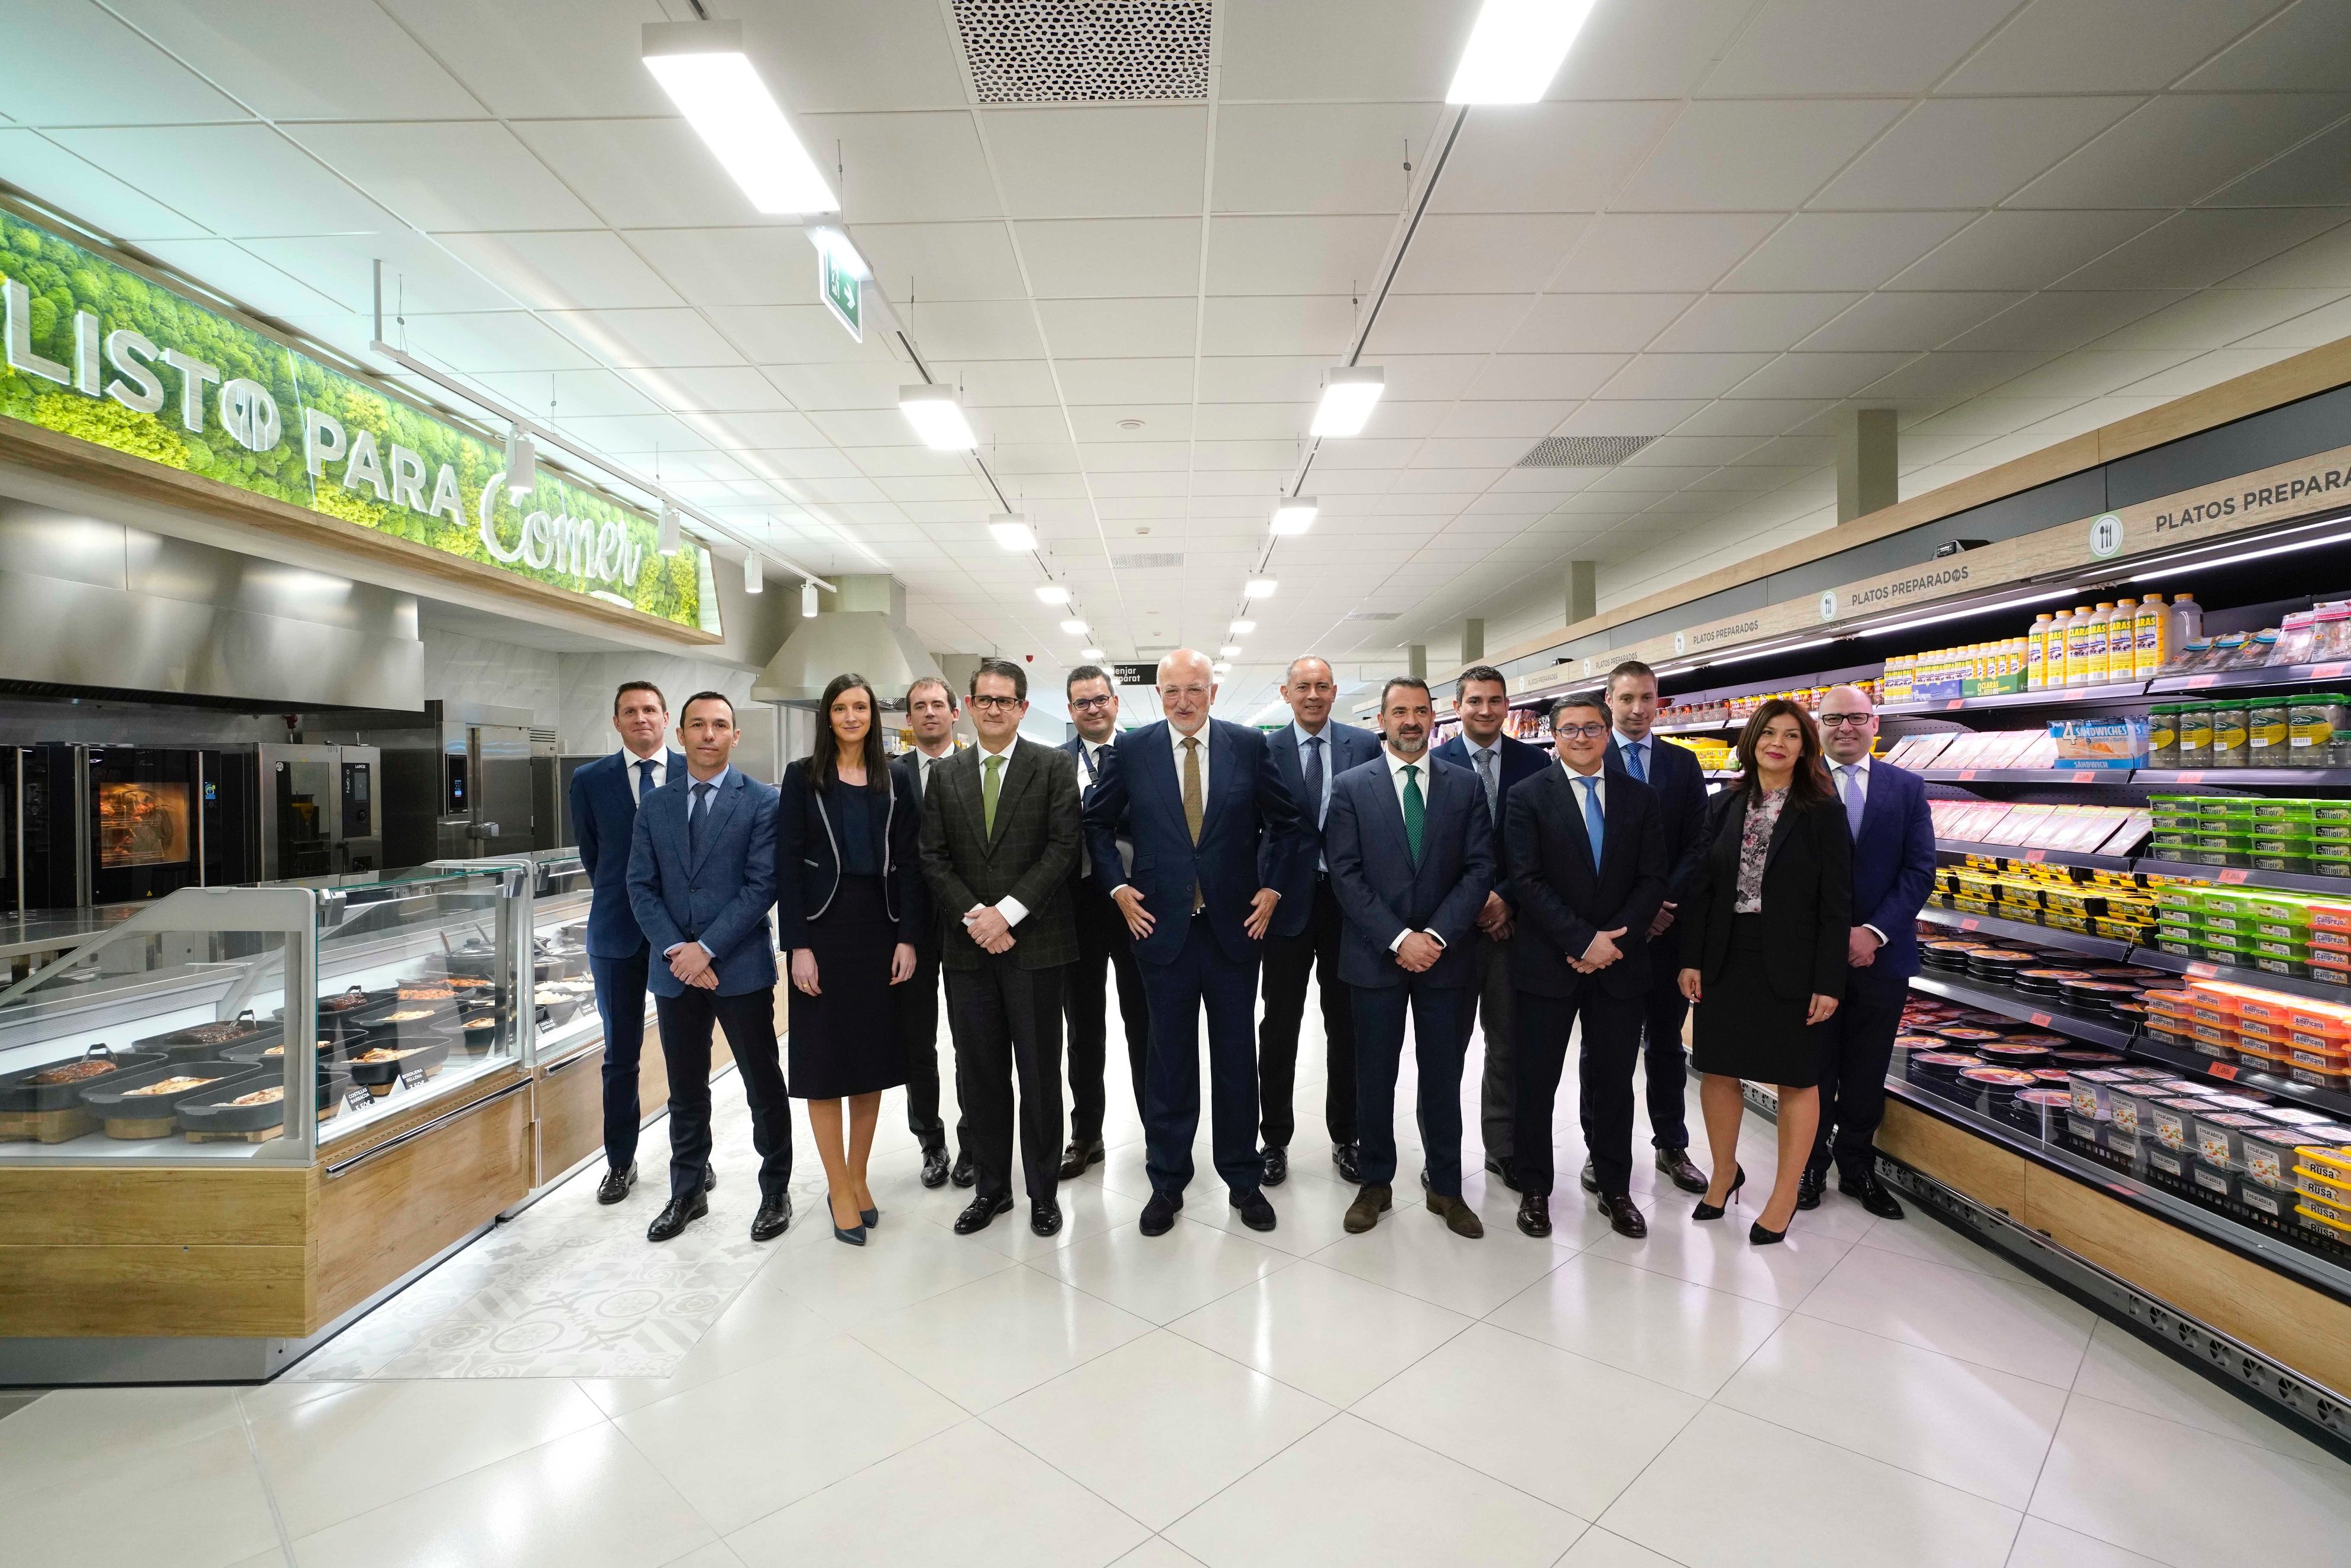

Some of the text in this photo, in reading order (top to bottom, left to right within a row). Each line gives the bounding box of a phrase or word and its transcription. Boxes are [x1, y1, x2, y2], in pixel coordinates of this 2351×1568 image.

[4, 278, 468, 526] LISTO PARA
[2156, 497, 2236, 532] PLATOS
[480, 471, 643, 587] Comer
[1852, 566, 1968, 606] PLATOS PREPARADOS
[1693, 620, 1759, 644] PLATOS PREPARADOS
[2088, 624, 2106, 634] ARAS
[1596, 659, 1610, 669] PLATOS
[1115, 666, 1136, 676] enjar
[1981, 681, 1999, 689] CLARAS
[2062, 721, 2127, 745] 4 SANDWICHES
[2317, 916, 2343, 926] Cangrejo
[2317, 935, 2343, 944] Cangrejo
[2317, 953, 2343, 963] Cangrejo
[2316, 971, 2342, 981] Cangrejo
[2197, 994, 2219, 1005] Americana
[2152, 1001, 2173, 1010] Americana
[2244, 1005, 2268, 1016] Americana
[2152, 1016, 2173, 1026] Americana
[2197, 1011, 2219, 1021] Americana
[2244, 1023, 2268, 1034] Americana
[2295, 1018, 2323, 1029] Americana
[2152, 1032, 2173, 1042] Americana
[2197, 1028, 2219, 1038] Americana
[2243, 1040, 2268, 1051] Americana
[2296, 1035, 2324, 1047] Americana
[2197, 1044, 2219, 1054] Americana
[2243, 1057, 2267, 1068] Americana
[2296, 1053, 2324, 1065] Americana
[401, 1068, 423, 1079] BERENJENA
[406, 1074, 423, 1083] RELLENA
[2295, 1071, 2323, 1084] Americana
[348, 1087, 368, 1099] COSTILLAS
[2072, 1084, 2092, 1094] Ensaladilla
[350, 1092, 370, 1104] BARBACOA
[2112, 1097, 2132, 1109] Ensaladilla
[2156, 1112, 2177, 1124] Ensaladilla
[2199, 1128, 2223, 1140] Ensaladilla
[2111, 1138, 2131, 1150] Ensaladilla
[2248, 1145, 2274, 1159] Ensaladilla
[2154, 1154, 2175, 1167] Ensaladilla
[2310, 1163, 2334, 1178] Rusa
[2198, 1172, 2222, 1185] Ensaladilla
[2308, 1183, 2332, 1199] Rusa
[2246, 1192, 2272, 1206] Ensaladilla
[2310, 1204, 2335, 1220] Rusa
[2310, 1223, 2335, 1239] Rusa
